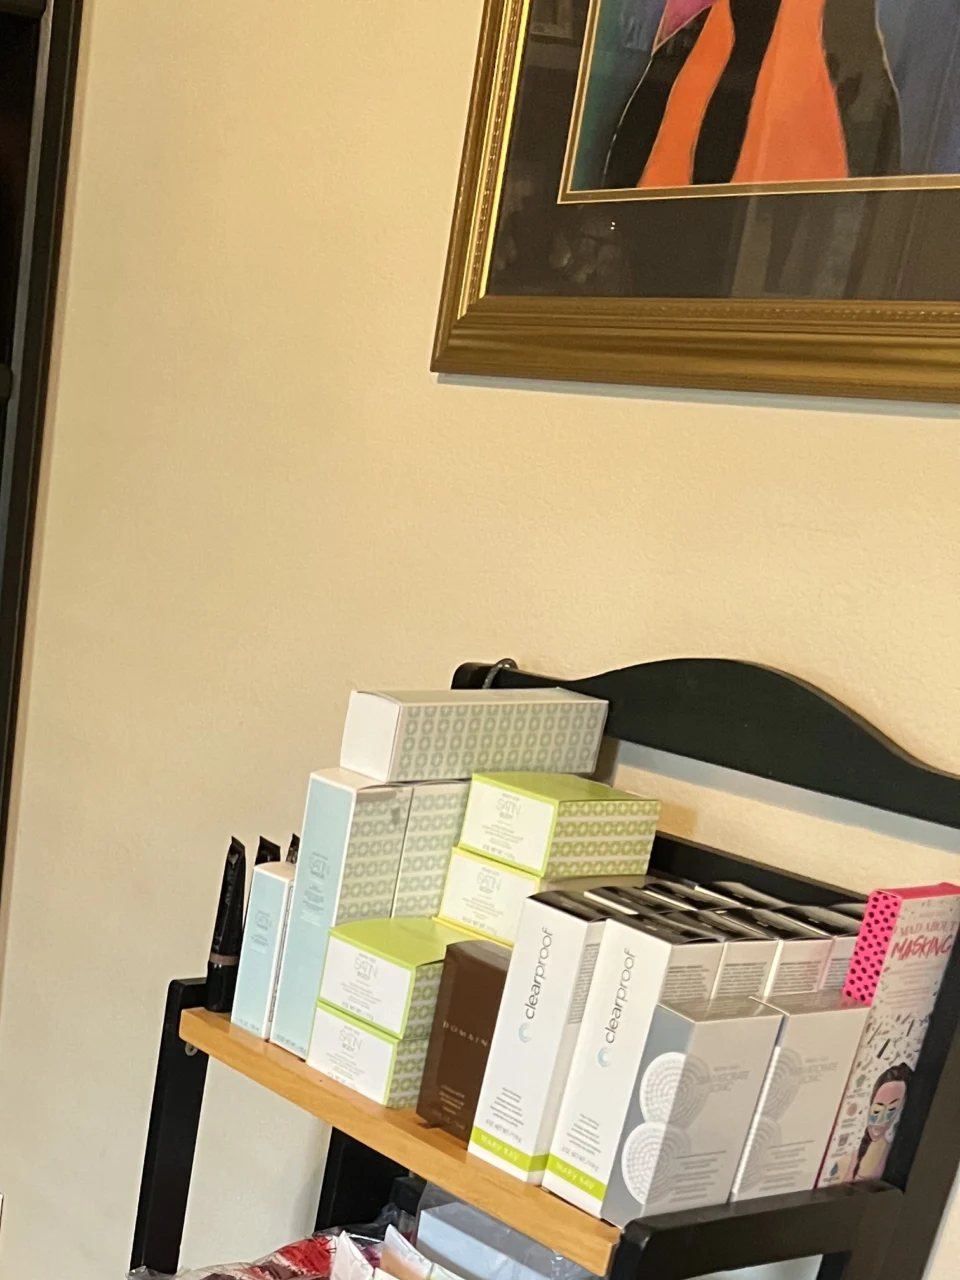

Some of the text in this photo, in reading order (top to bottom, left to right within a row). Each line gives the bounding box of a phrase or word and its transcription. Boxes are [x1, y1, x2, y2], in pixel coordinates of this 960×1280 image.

[524, 926, 554, 1020] clearproof
[604, 947, 637, 1044] clearproof
[442, 1020, 488, 1047] DOMAIN
